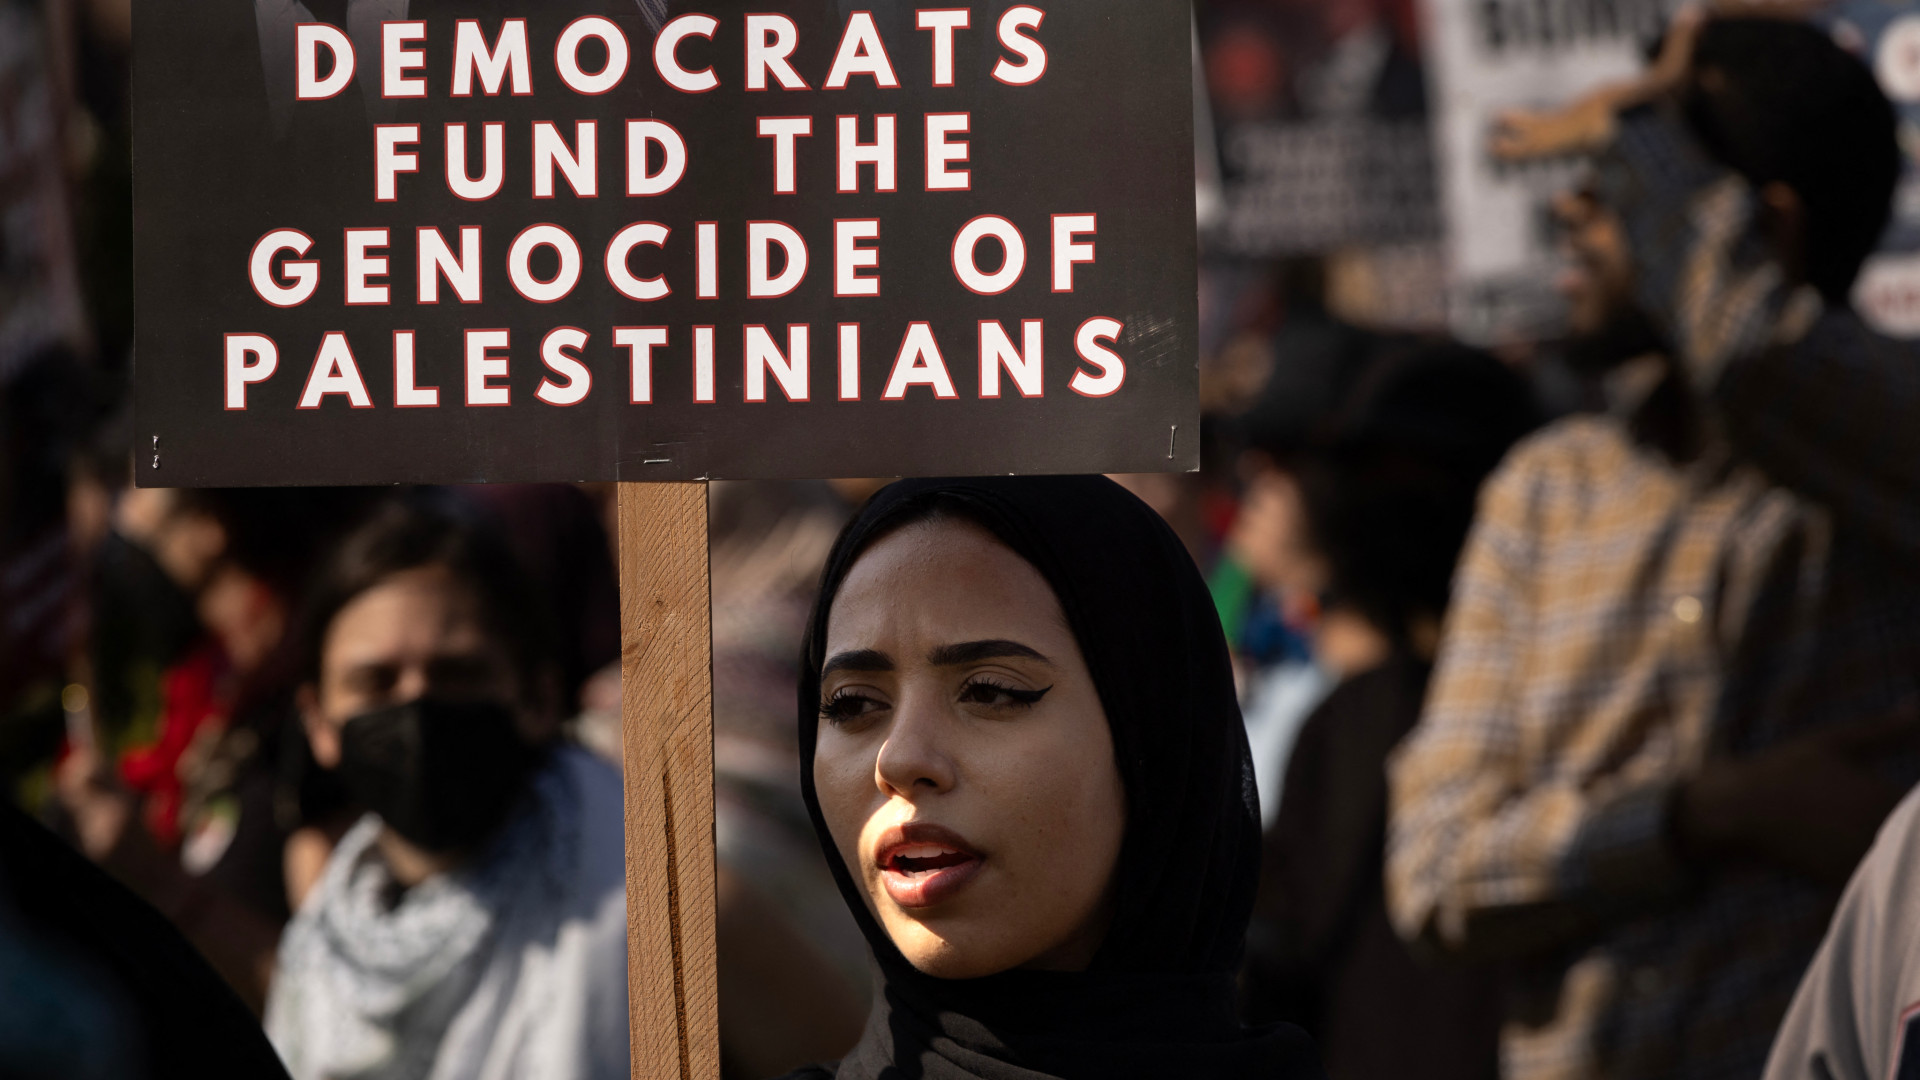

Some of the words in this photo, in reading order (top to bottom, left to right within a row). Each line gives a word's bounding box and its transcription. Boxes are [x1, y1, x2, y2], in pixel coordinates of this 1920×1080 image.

[295, 5, 1048, 101] DEMOCRATS
[374, 118, 688, 202] FUND
[756, 112, 971, 195] THE
[248, 217, 880, 308] GENOCIDE
[951, 213, 1097, 296] OF
[223, 316, 1127, 411] PALESTINIANS
